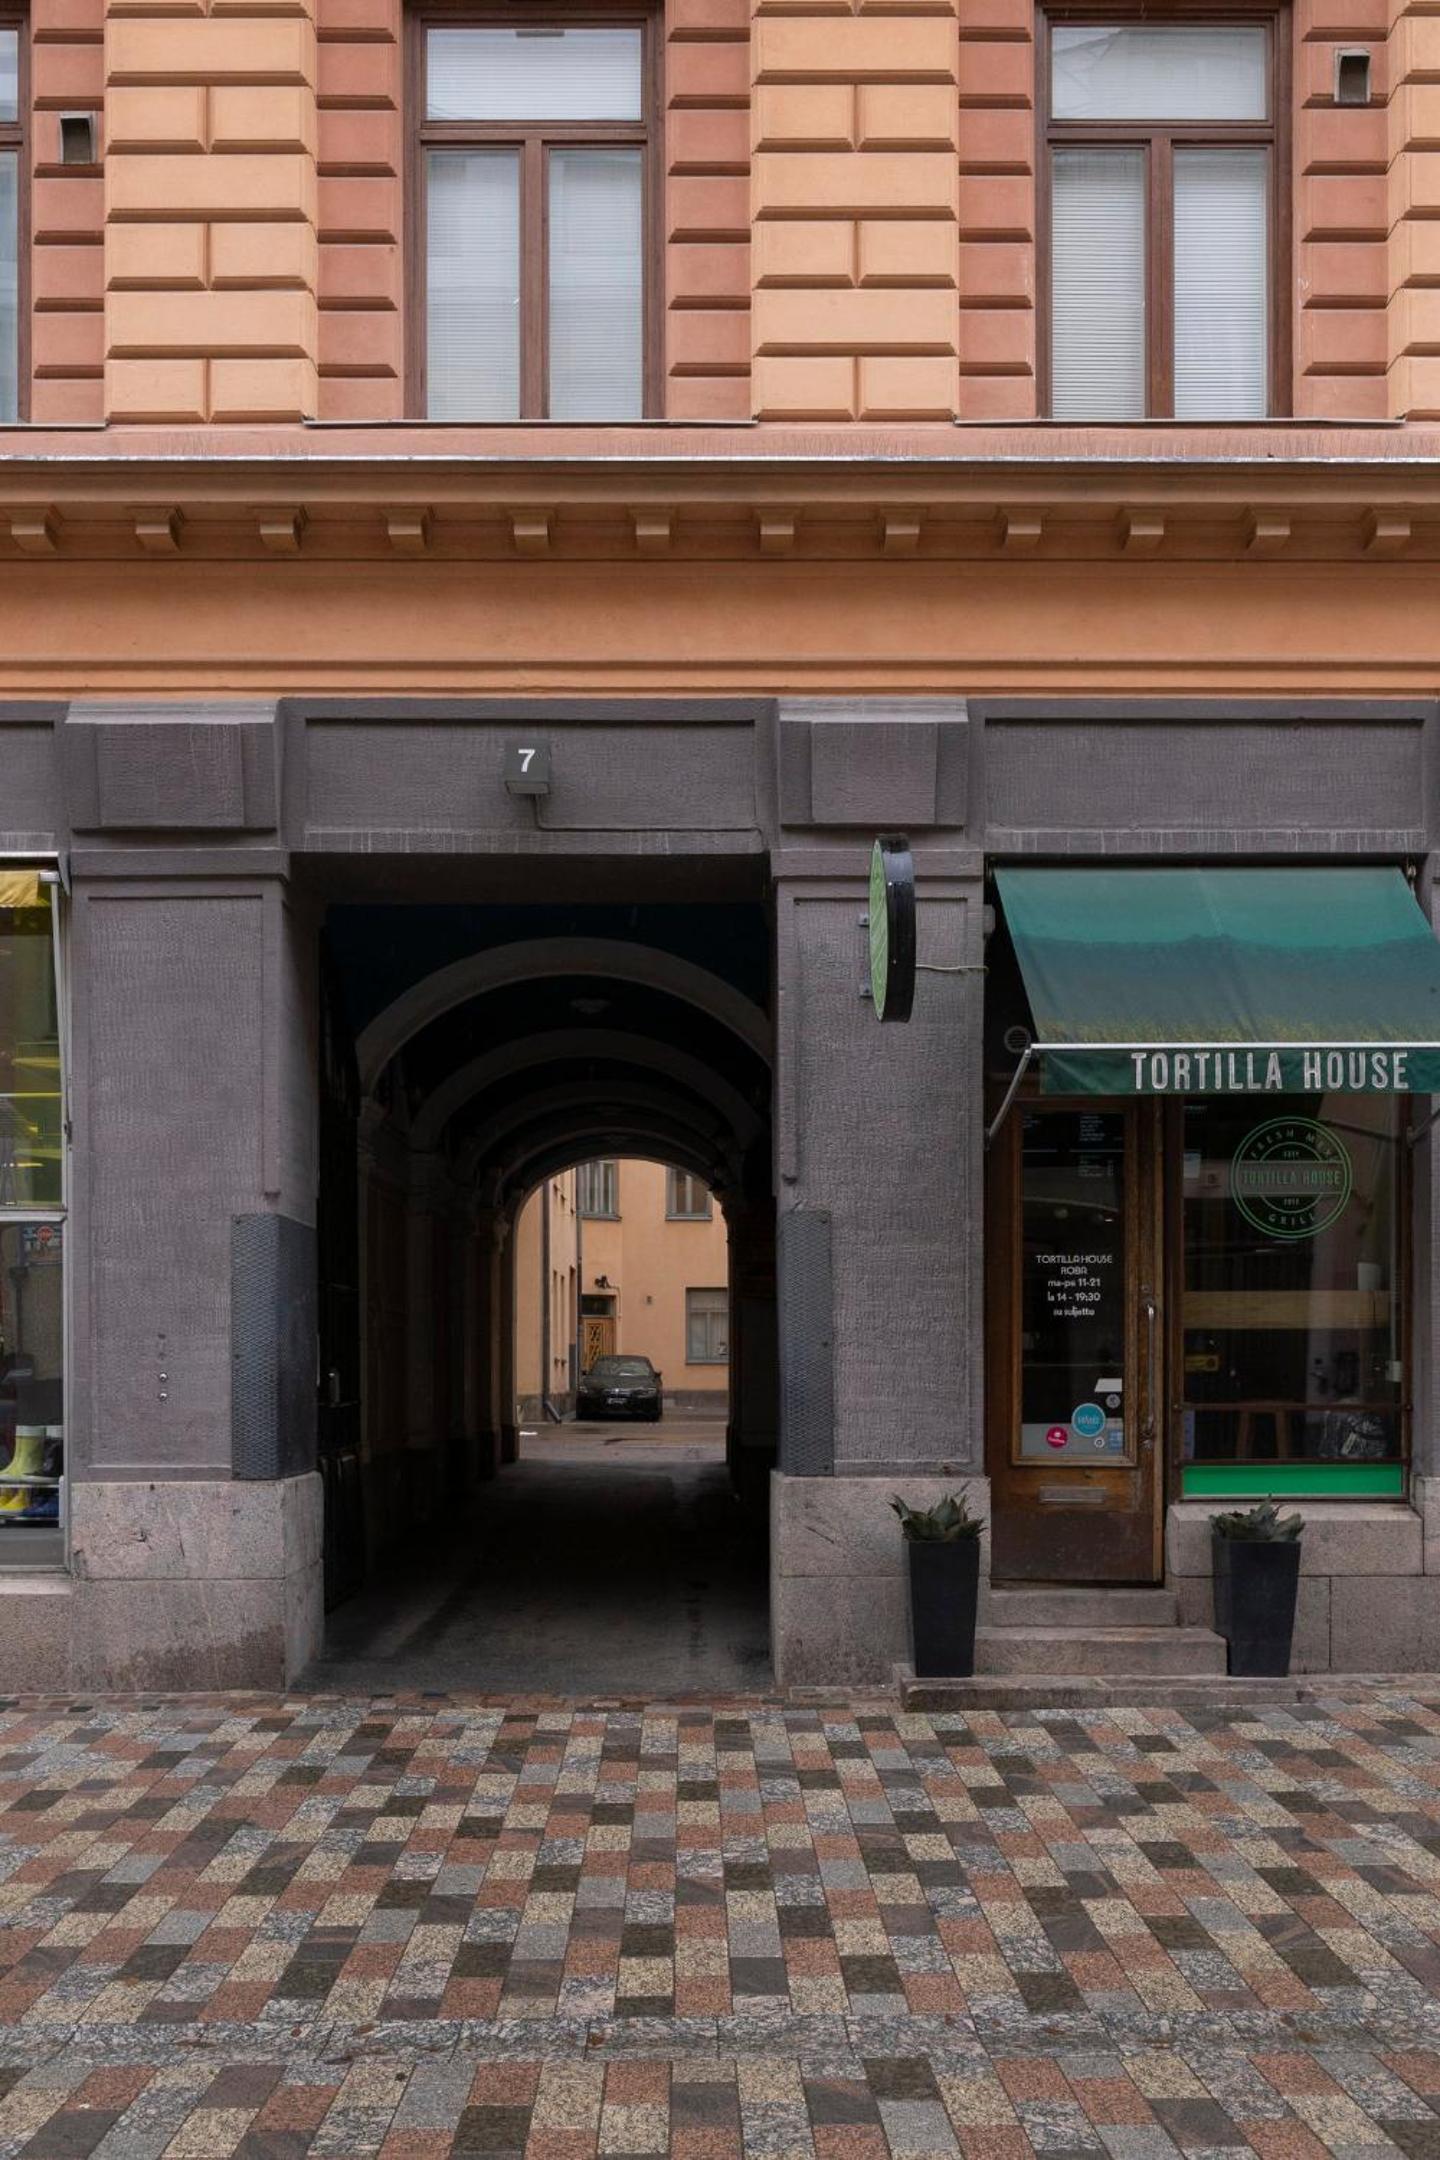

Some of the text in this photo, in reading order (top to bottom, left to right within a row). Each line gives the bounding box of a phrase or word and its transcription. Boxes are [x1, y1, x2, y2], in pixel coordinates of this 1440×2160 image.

[517, 748, 536, 773] 7
[1130, 1051, 1410, 1090] TORTILLA HOUSE
[1243, 1169, 1342, 1185] TORTILLA HOUSE
[1035, 1255, 1113, 1264] TORTILLA HOUSE
[1057, 1292, 1067, 1302] 14
[1075, 1292, 1102, 1302] 19:30
